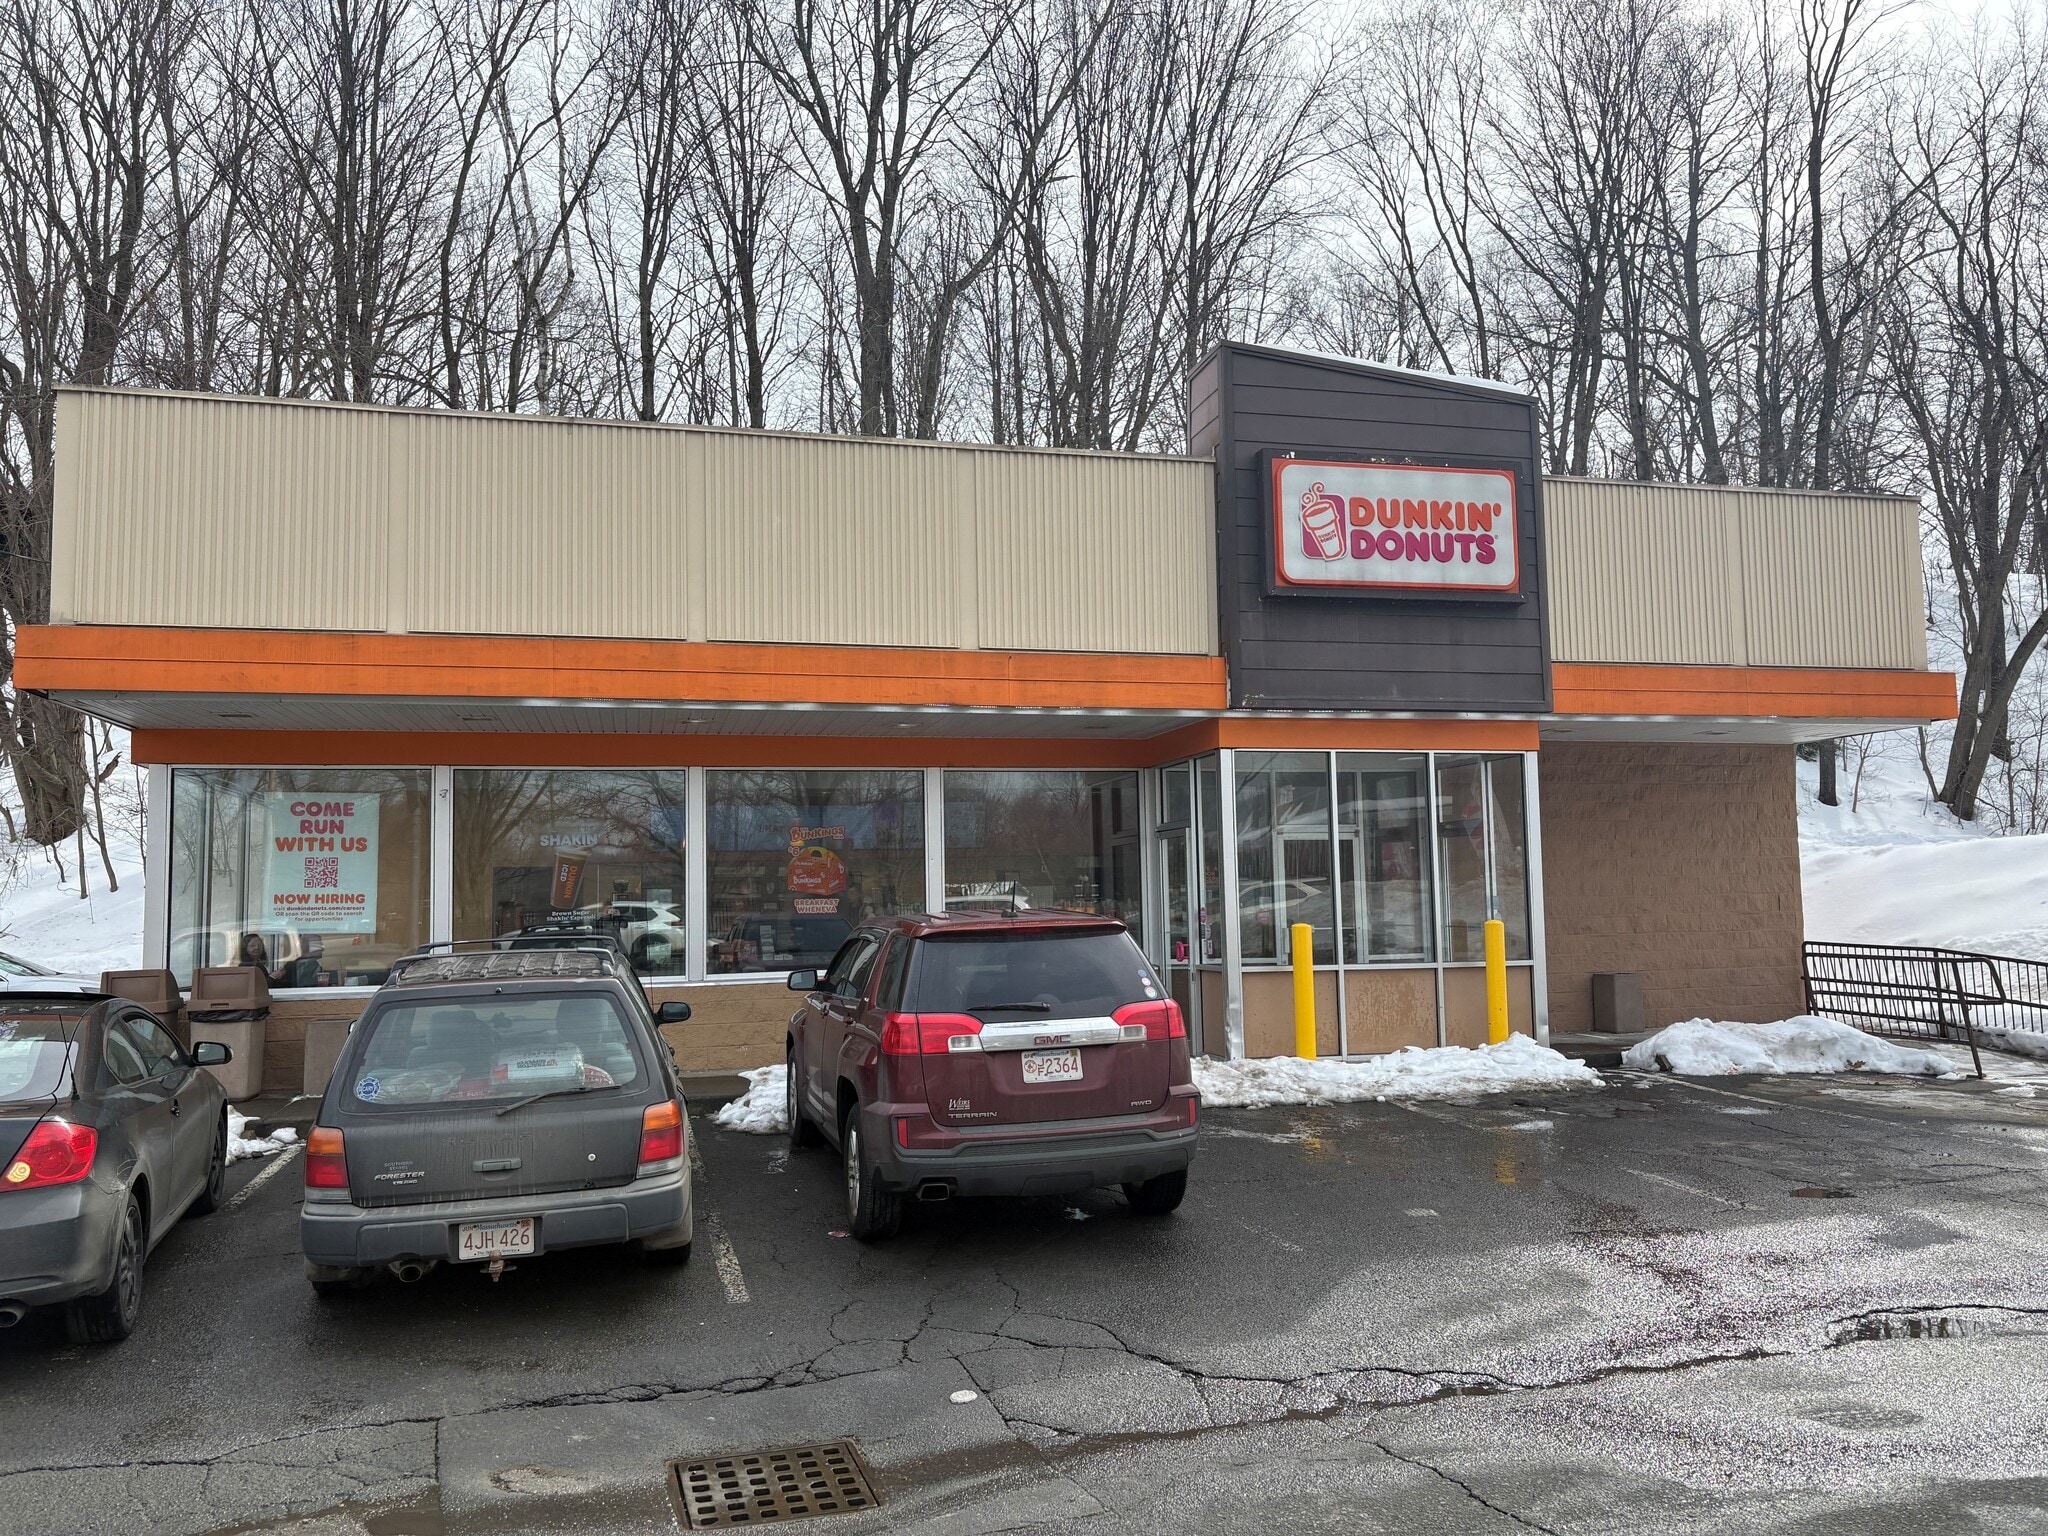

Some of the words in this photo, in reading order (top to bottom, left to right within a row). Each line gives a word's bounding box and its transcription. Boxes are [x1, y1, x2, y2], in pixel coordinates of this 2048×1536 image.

[1349, 496, 1502, 532] DUNKIN'
[1350, 529, 1497, 565] DONUTS
[290, 802, 355, 817] COME
[300, 819, 345, 835] RUN
[791, 826, 844, 840] DUNKINGS
[275, 836, 335, 852] WITH
[340, 836, 368, 852] US
[560, 864, 569, 882] ICED
[273, 893, 311, 905] NOW
[314, 893, 366, 904] HIRING
[795, 899, 839, 907] BREAKFAST
[1034, 1034, 1071, 1046] GMC
[1045, 1057, 1078, 1074] 2364
[374, 1171, 425, 1181] FORESTER
[476, 1221, 518, 1230] Massachusetts
[464, 1231, 494, 1250] 4JH
[499, 1228, 530, 1247] 426
